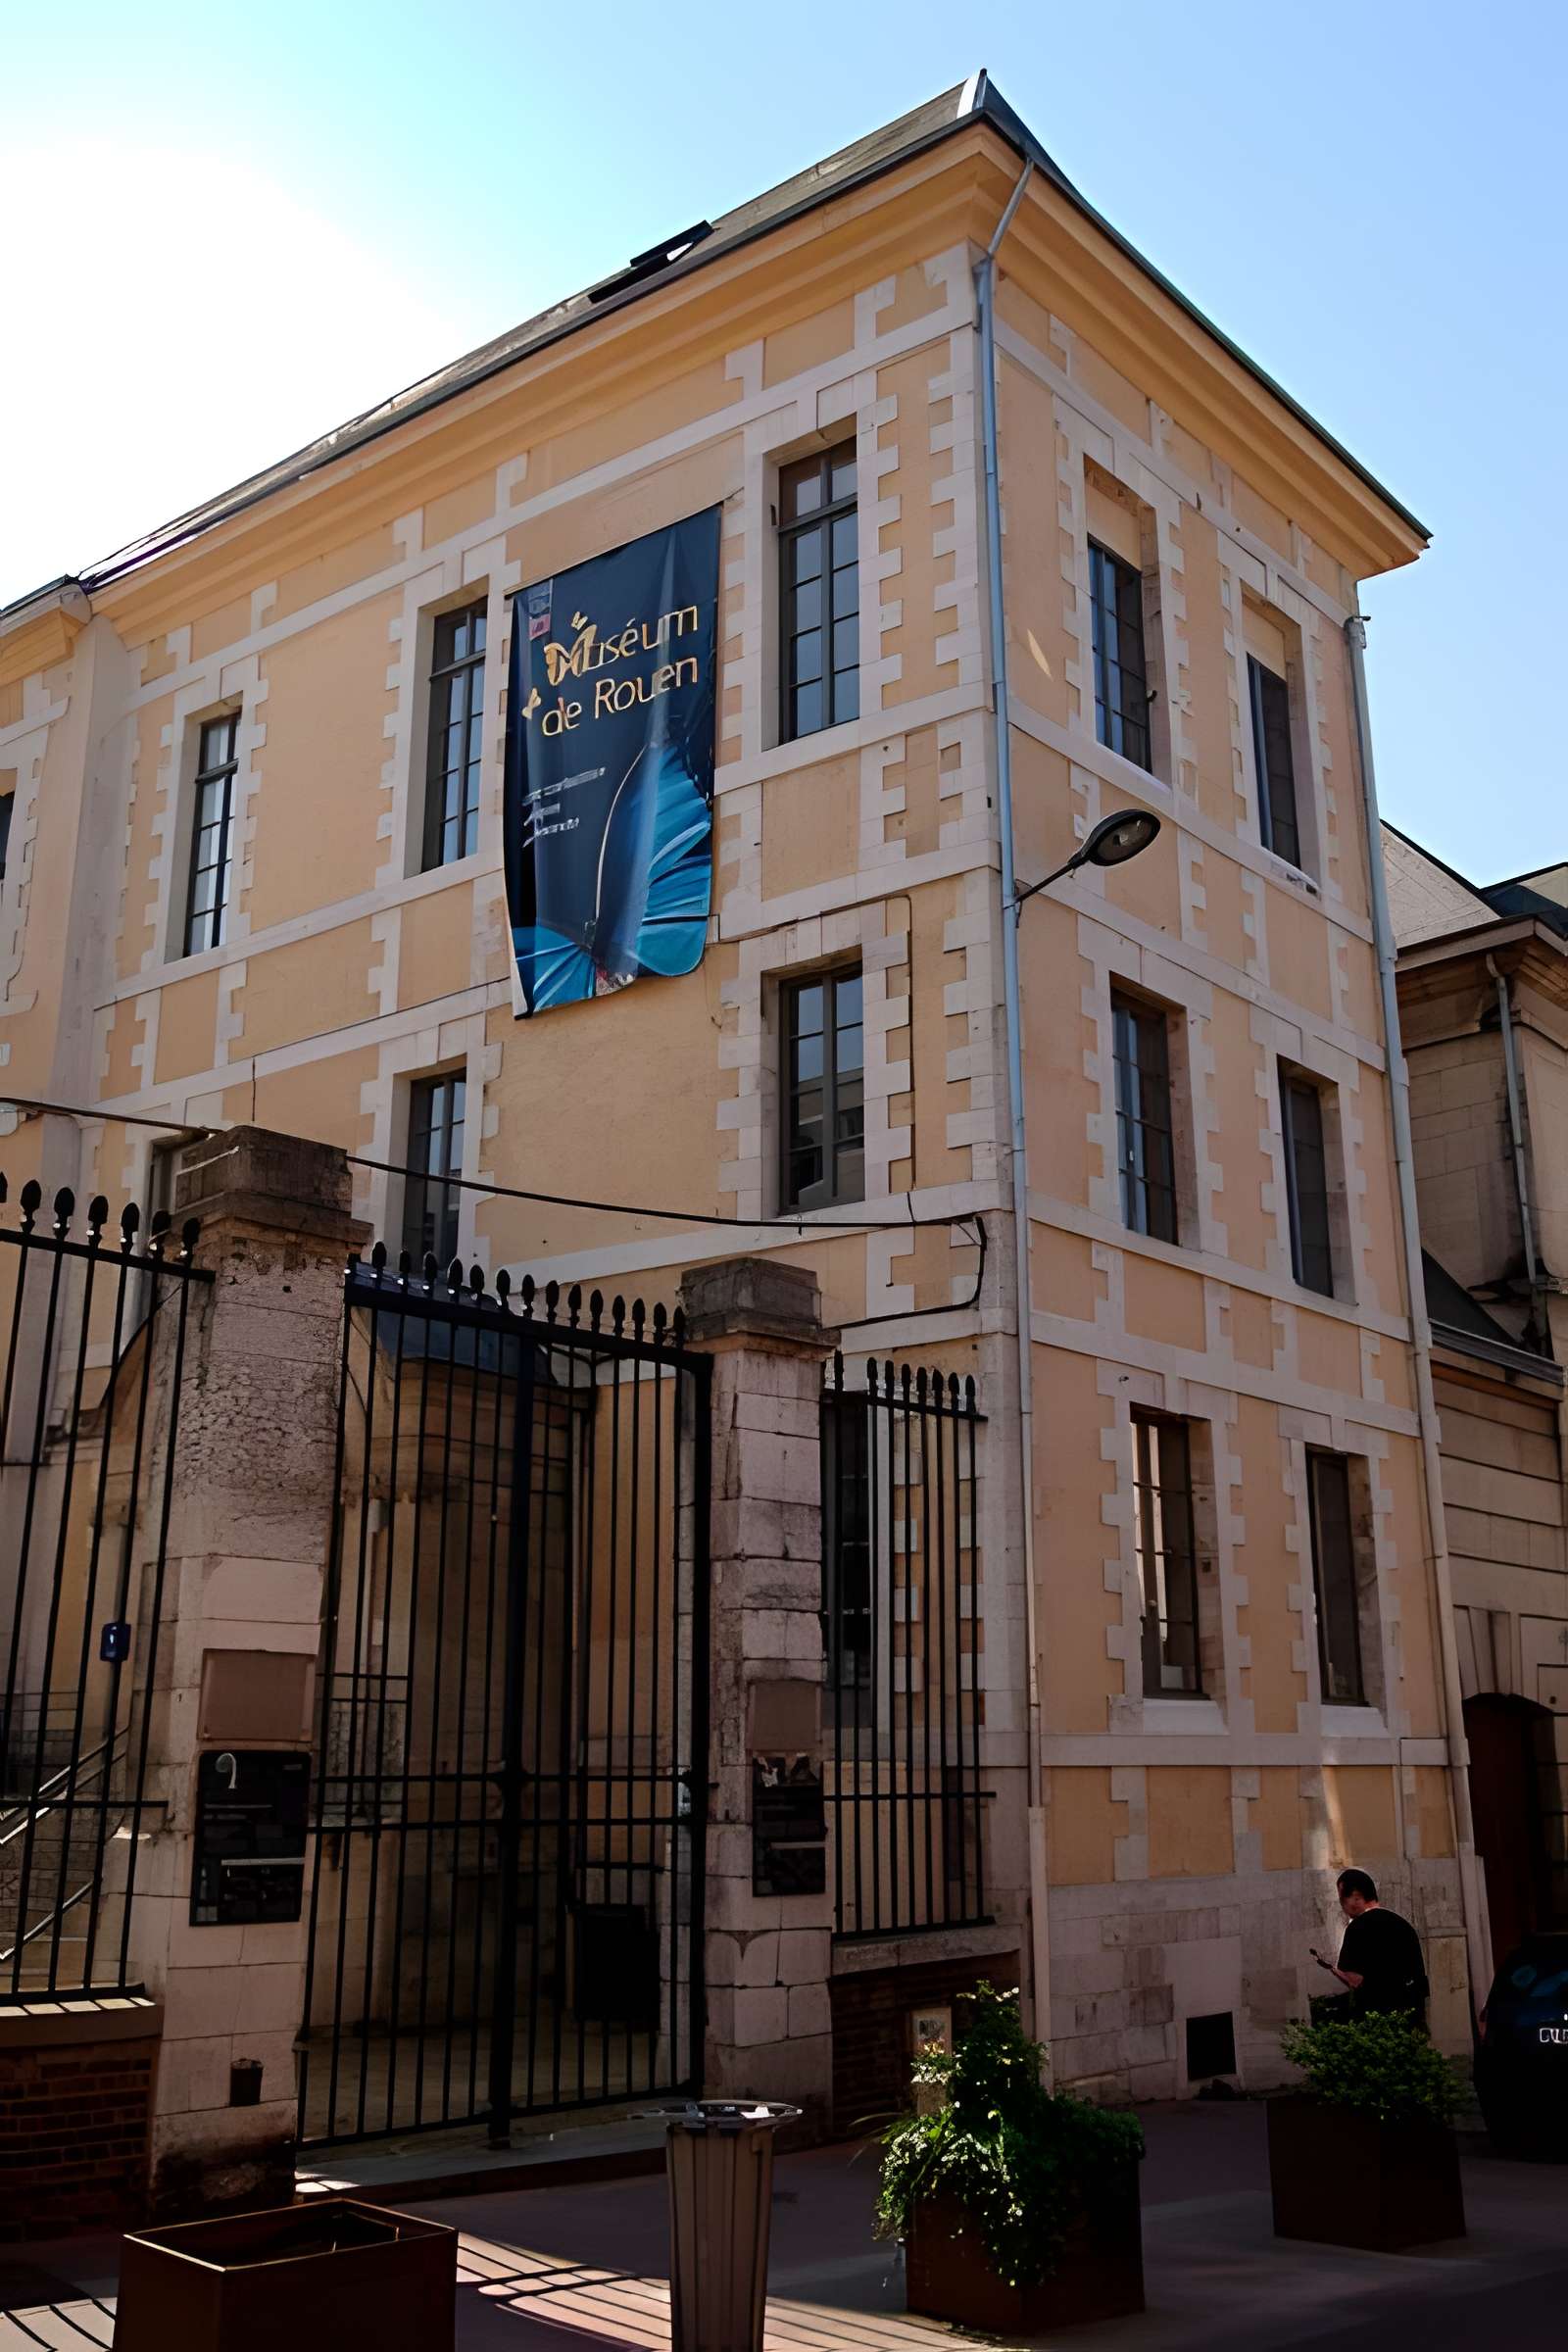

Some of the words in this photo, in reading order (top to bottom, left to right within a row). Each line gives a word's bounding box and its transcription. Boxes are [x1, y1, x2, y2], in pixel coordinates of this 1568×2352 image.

[544, 606, 698, 685] Muséum
[542, 697, 582, 736] de
[595, 657, 698, 719] Rouen
